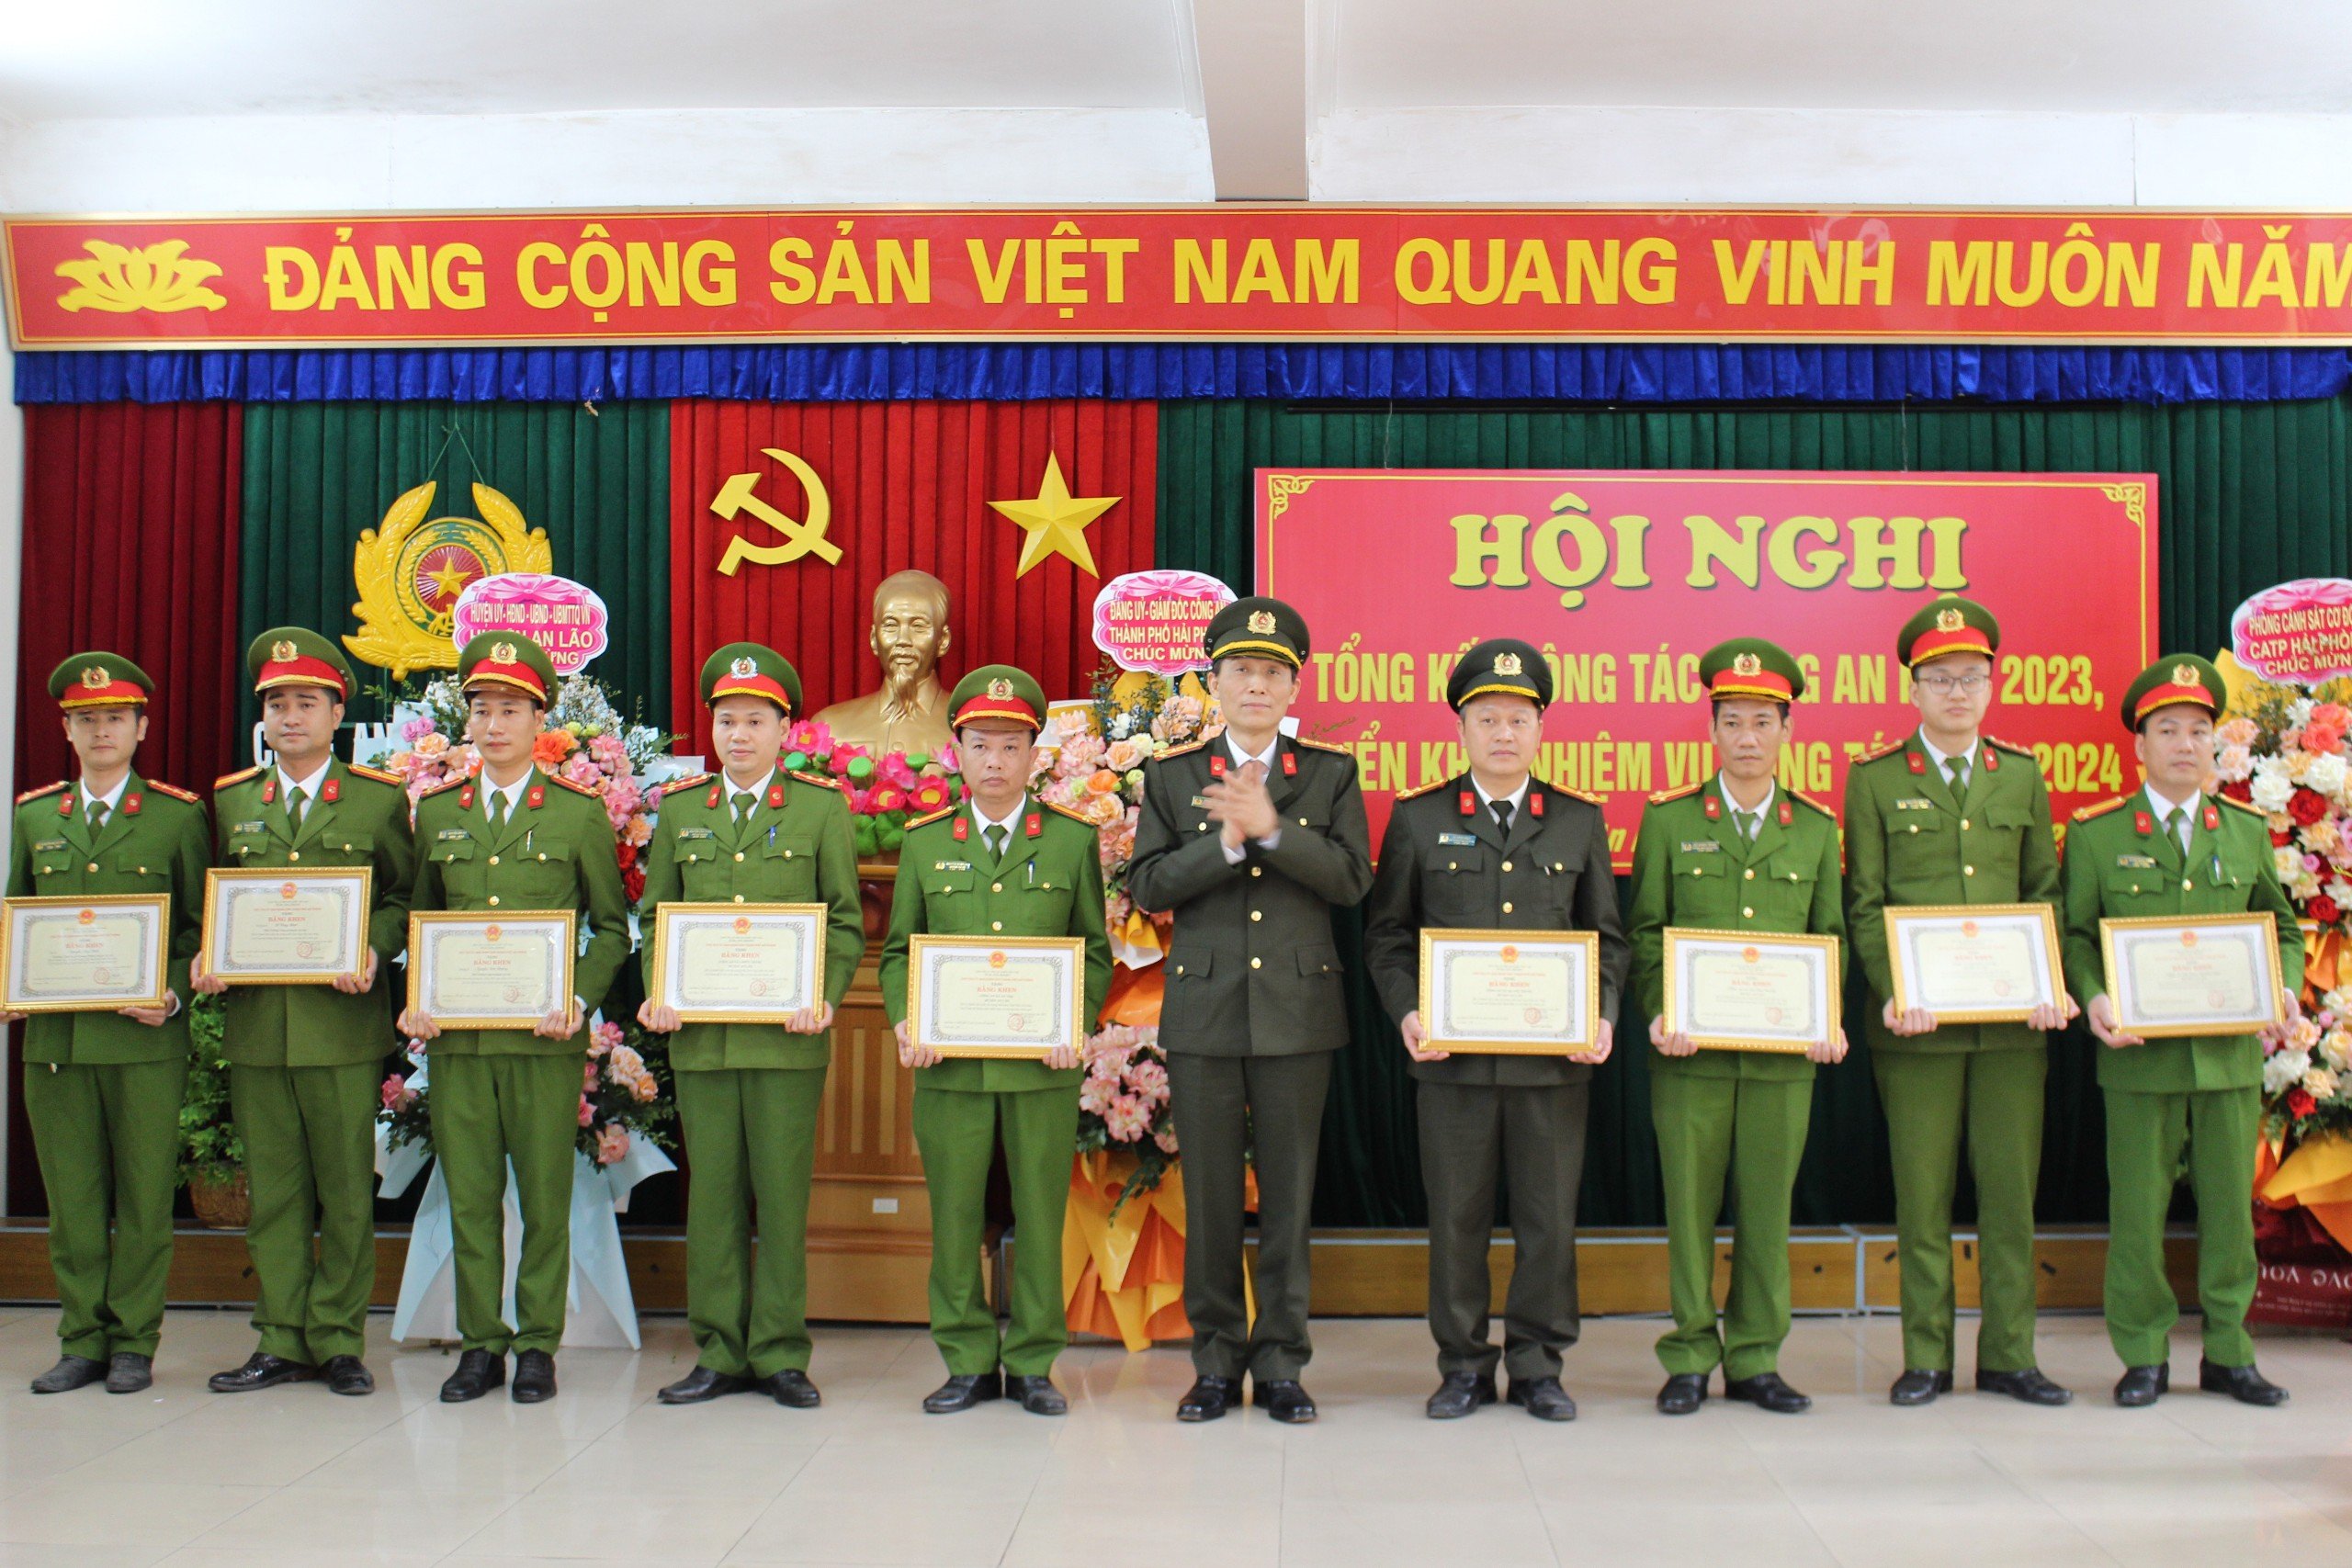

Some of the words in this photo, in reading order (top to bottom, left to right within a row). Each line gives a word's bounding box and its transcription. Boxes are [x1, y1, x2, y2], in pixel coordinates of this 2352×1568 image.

[262, 226, 486, 311] ĐẢNG
[516, 223, 737, 323] CỘNG
[769, 220, 932, 305] SẢN
[965, 220, 1140, 319] VIỆT
[1174, 238, 1360, 304] NAM
[1395, 237, 1678, 305] QUANG
[1712, 239, 1896, 306] VINH
[1926, 221, 2161, 308] MUÔN
[2186, 224, 2352, 310] NĂM
[1449, 491, 1652, 609] HỘI
[1684, 514, 1970, 599] NGHỊ
[530, 604, 548, 624] UBND
[1149, 595, 1170, 621] GIÁM
[1190, 595, 1213, 621] CÔNG
[532, 629, 554, 648] AN
[559, 627, 594, 649] LÃO
[1109, 623, 1146, 644] THÀNH
[1172, 622, 1192, 643] HẢI
[1123, 644, 1166, 660] CHÚC
[1170, 644, 1206, 660] MỪN
[2249, 637, 2288, 660] CATP
[1312, 632, 1415, 704] TỔNG
[1543, 642, 1617, 705] ÔNG
[1627, 642, 1702, 704] TÁC
[1833, 654, 1887, 705] AN
[2000, 654, 2105, 712] 2023,
[2266, 653, 2310, 675] CHÚC
[2314, 651, 2352, 670] MỪN
[2031, 741, 2123, 794] 2024
